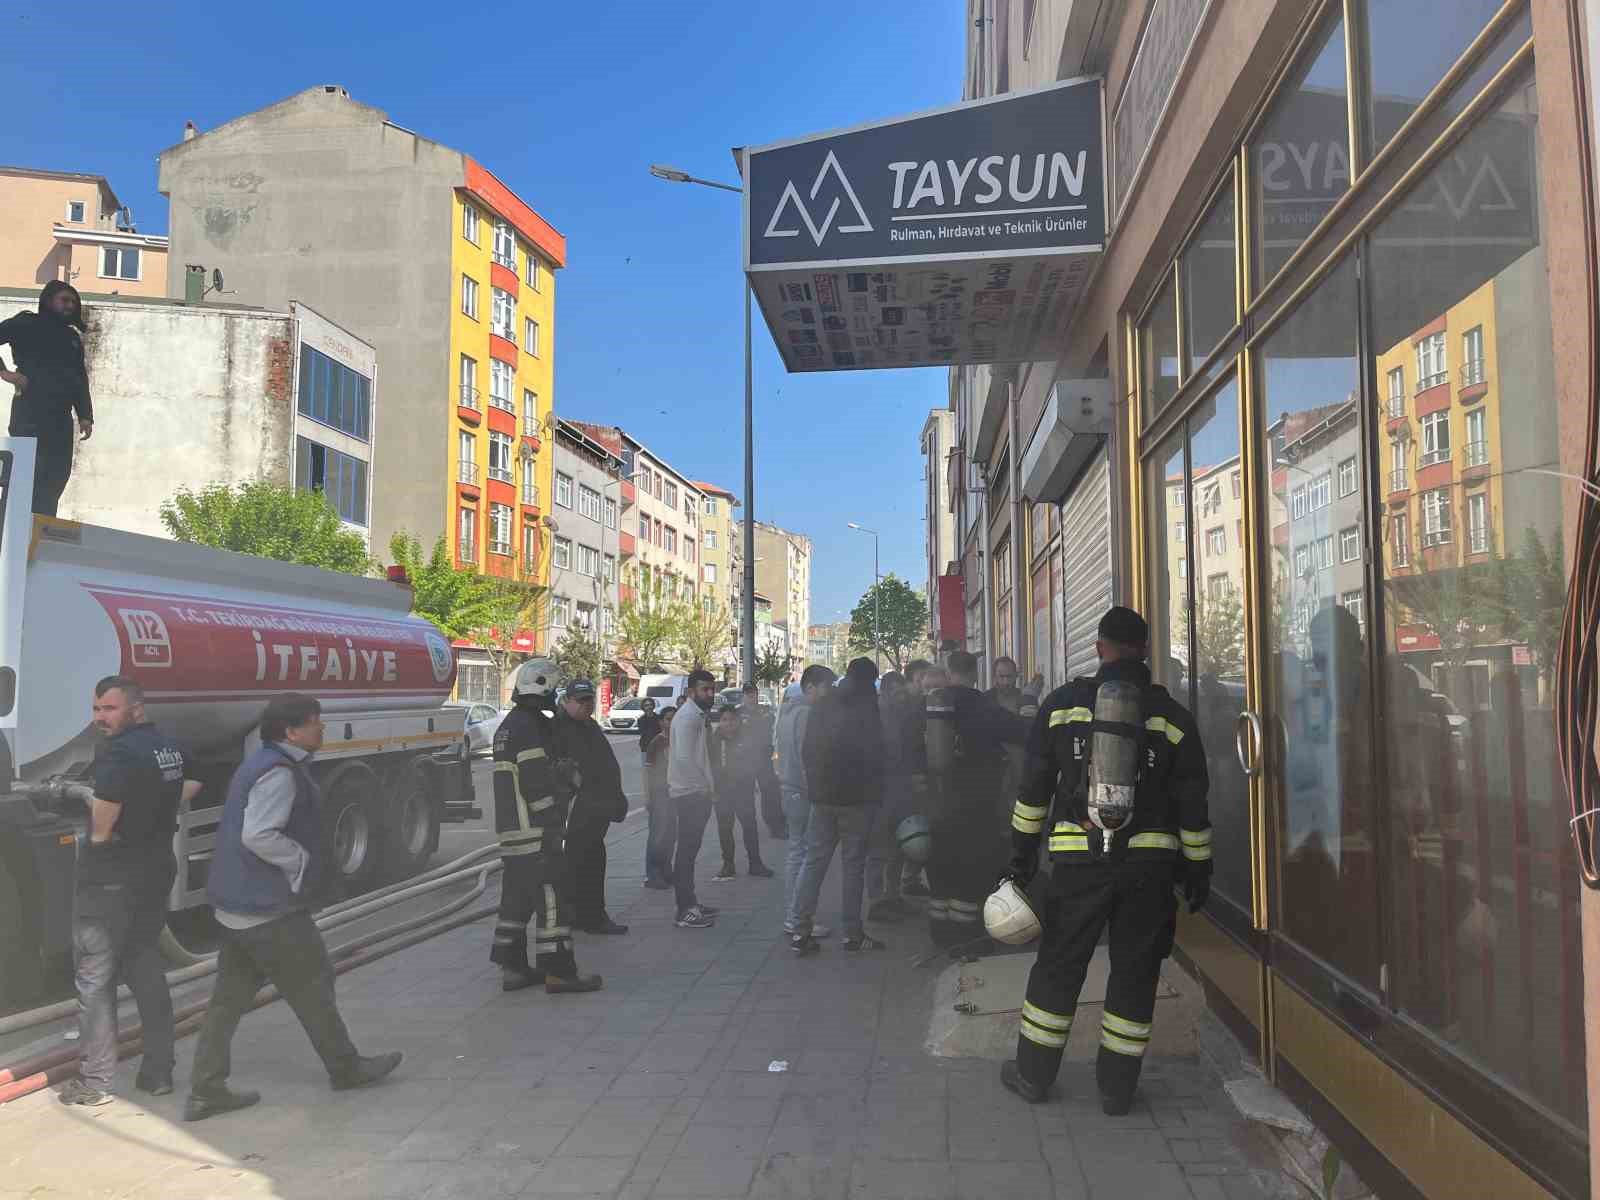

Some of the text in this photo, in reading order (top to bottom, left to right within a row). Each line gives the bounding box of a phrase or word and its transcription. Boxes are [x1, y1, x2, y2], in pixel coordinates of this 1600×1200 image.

[888, 150, 1087, 209] TAYSUN
[890, 215, 1087, 242] Rulman, Hırdavat ve Teknik Ürünler
[127, 614, 165, 640] 112
[252, 629, 398, 681] İTFAİYE
